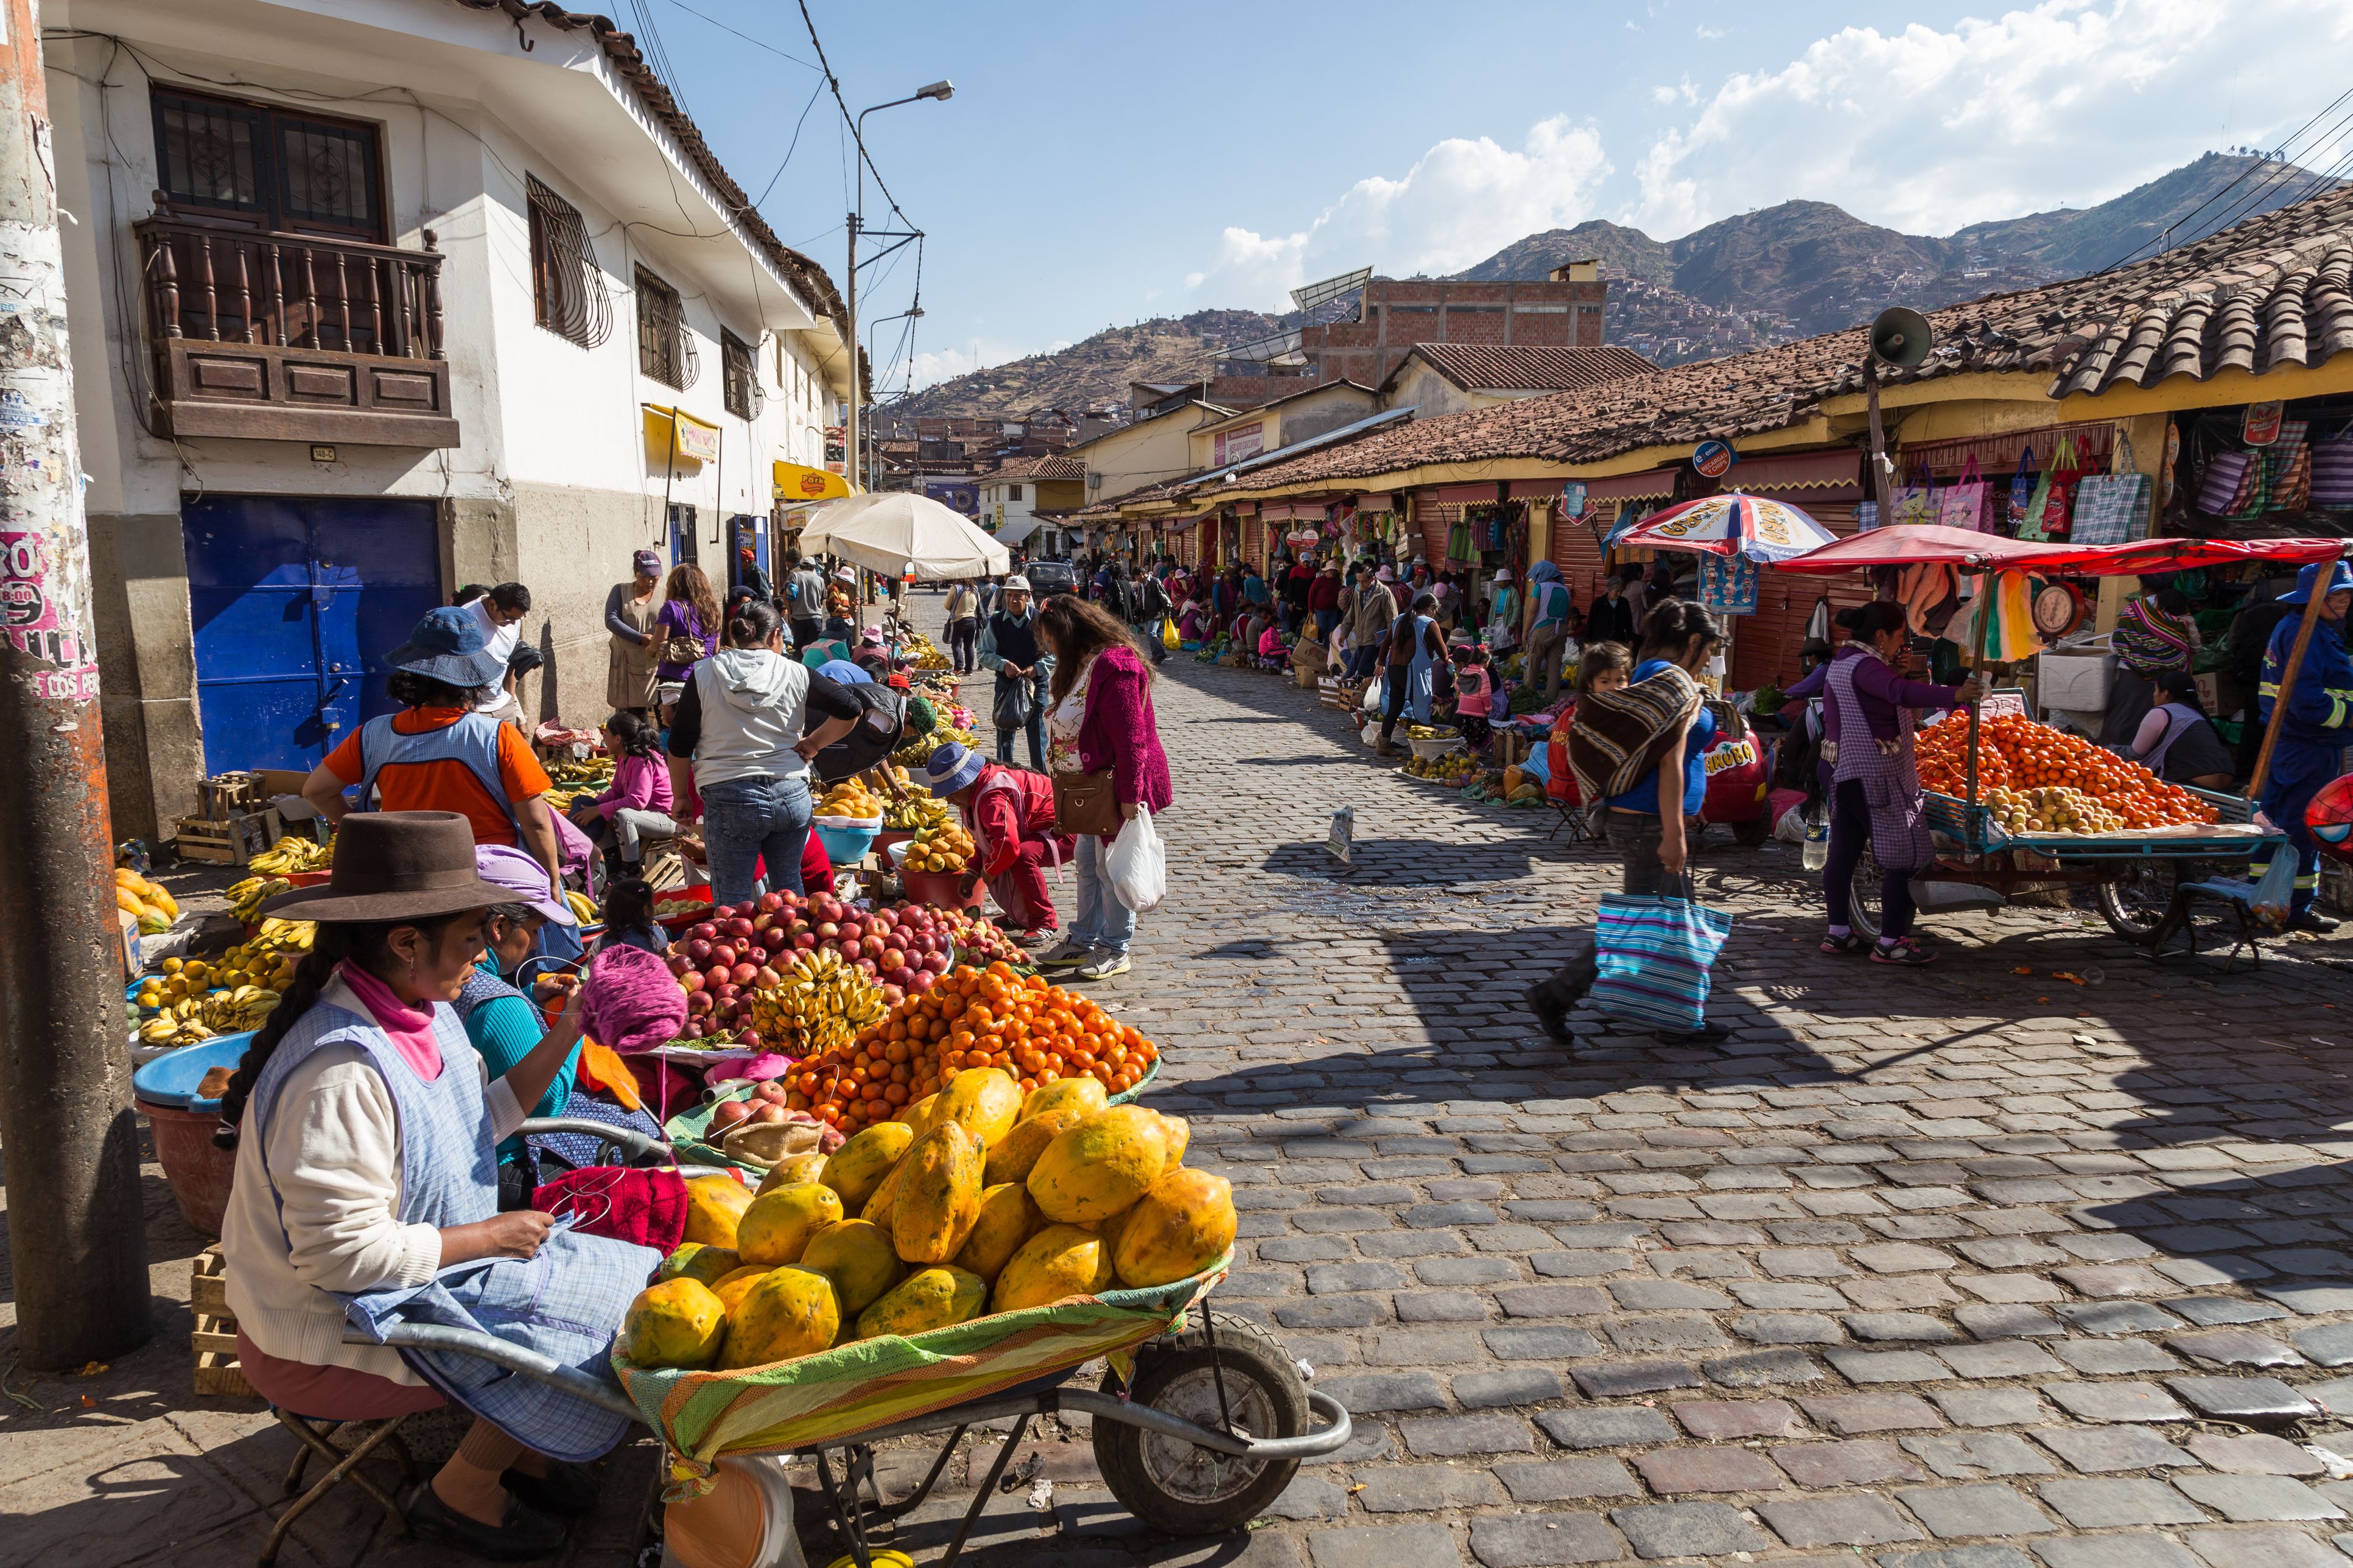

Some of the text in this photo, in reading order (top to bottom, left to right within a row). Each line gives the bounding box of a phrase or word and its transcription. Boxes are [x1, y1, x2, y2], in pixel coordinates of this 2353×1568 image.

[1705, 444, 1721, 456] entel
[1701, 452, 1728, 473] RECARGAS
[1711, 460, 1728, 472] CHIPS
[1756, 542, 1795, 556] Helados
[47, 673, 78, 698] LOS
[1705, 744, 1753, 773] ARUBA
